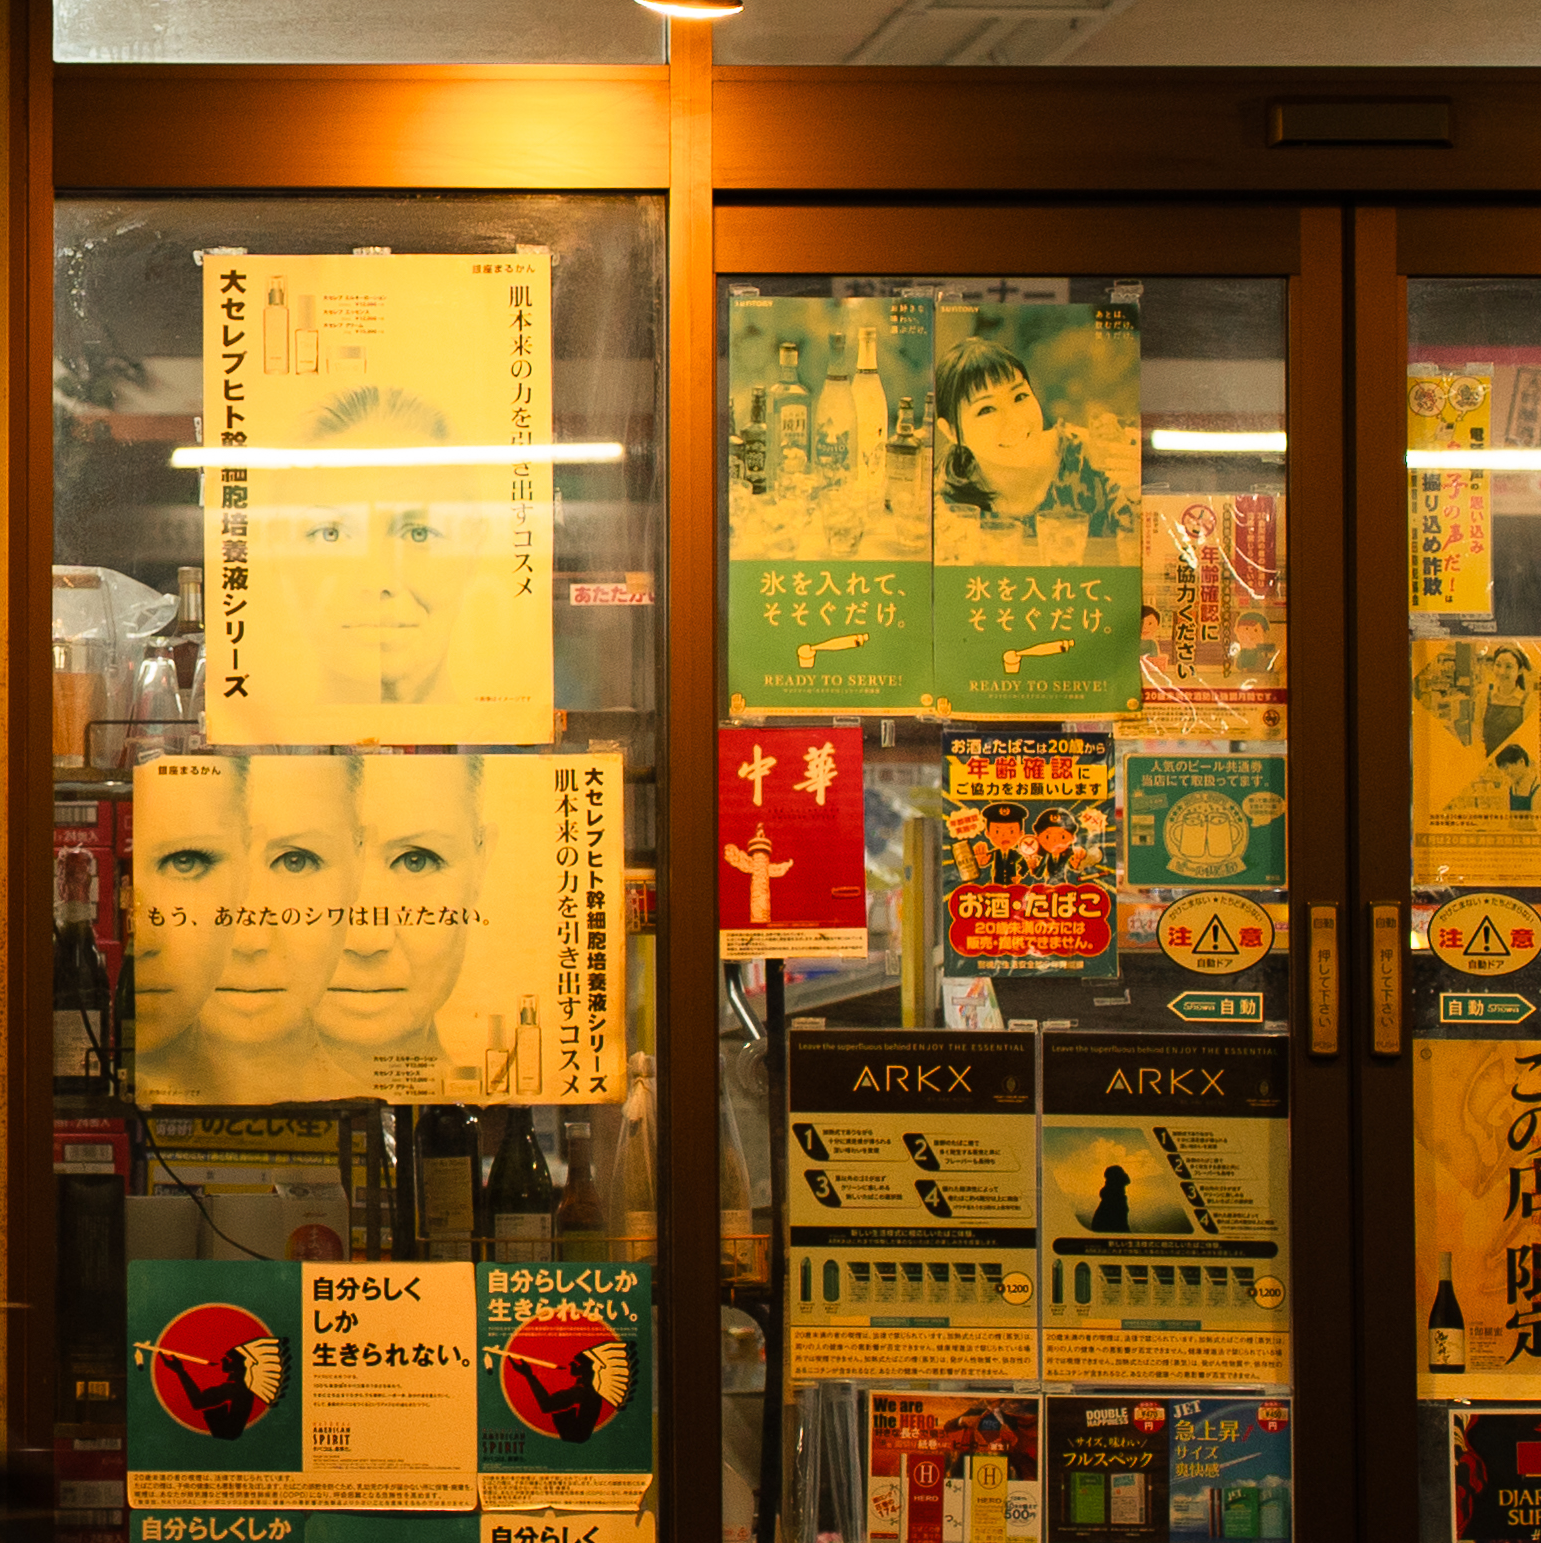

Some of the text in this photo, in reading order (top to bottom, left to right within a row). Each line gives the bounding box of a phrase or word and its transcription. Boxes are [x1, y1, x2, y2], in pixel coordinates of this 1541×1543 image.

[760, 571, 906, 597] 氷を入れて、
[965, 577, 1113, 603] 氷を入れて、
[1201, 546, 1218, 641] 年齢確認に
[763, 602, 905, 629] そそぐだけ。
[967, 608, 1112, 635] そそぐだけ。
[764, 675, 902, 686] READY TO SERVE!
[970, 681, 1108, 692] READY TO SERVE!
[951, 739, 1105, 754] お酒とたばこは20歳から
[158, 766, 221, 776] 銀座まるかん
[738, 742, 839, 806] 中華
[967, 758, 1090, 779] 年齢確認に
[956, 784, 1101, 796] ご協力をお願いします
[959, 893, 1101, 919] お酒・たばこ
[147, 907, 491, 928] もう、あなたのシワは目立たない。
[975, 922, 1085, 934] 20歳未満の方には
[554, 768, 582, 1096] 肌本来の力を引き出すコスメ
[585, 768, 608, 1094] 大セレブヒト幹細胞培養液シリーズ
[1197, 959, 1232, 968] 自動ドア
[1469, 960, 1504, 970] 自動ドア
[1221, 1000, 1255, 1015] 自動
[1448, 1000, 1483, 1016] 自動
[853, 1065, 972, 1092] ARKX
[1106, 1069, 1225, 1095] ARKX
[312, 1278, 422, 1302] 自分らしく
[488, 1270, 638, 1294] 自分らしくしか
[488, 1298, 638, 1322] 生きられない。
[314, 1311, 358, 1333] しか
[312, 1338, 470, 1368] 生きられない。
[873, 1398, 923, 1412] We are
[1086, 1408, 1128, 1419] DOUBLE
[1174, 1401, 1201, 1418] JET
[873, 1414, 896, 1428] the
[1175, 1420, 1239, 1442] 急上昇
[313, 1434, 350, 1445] SPIRIT
[1063, 1452, 1153, 1468] フルスペック
[1176, 1447, 1219, 1460] サイズ
[141, 1517, 291, 1542] 自分らしくしか
